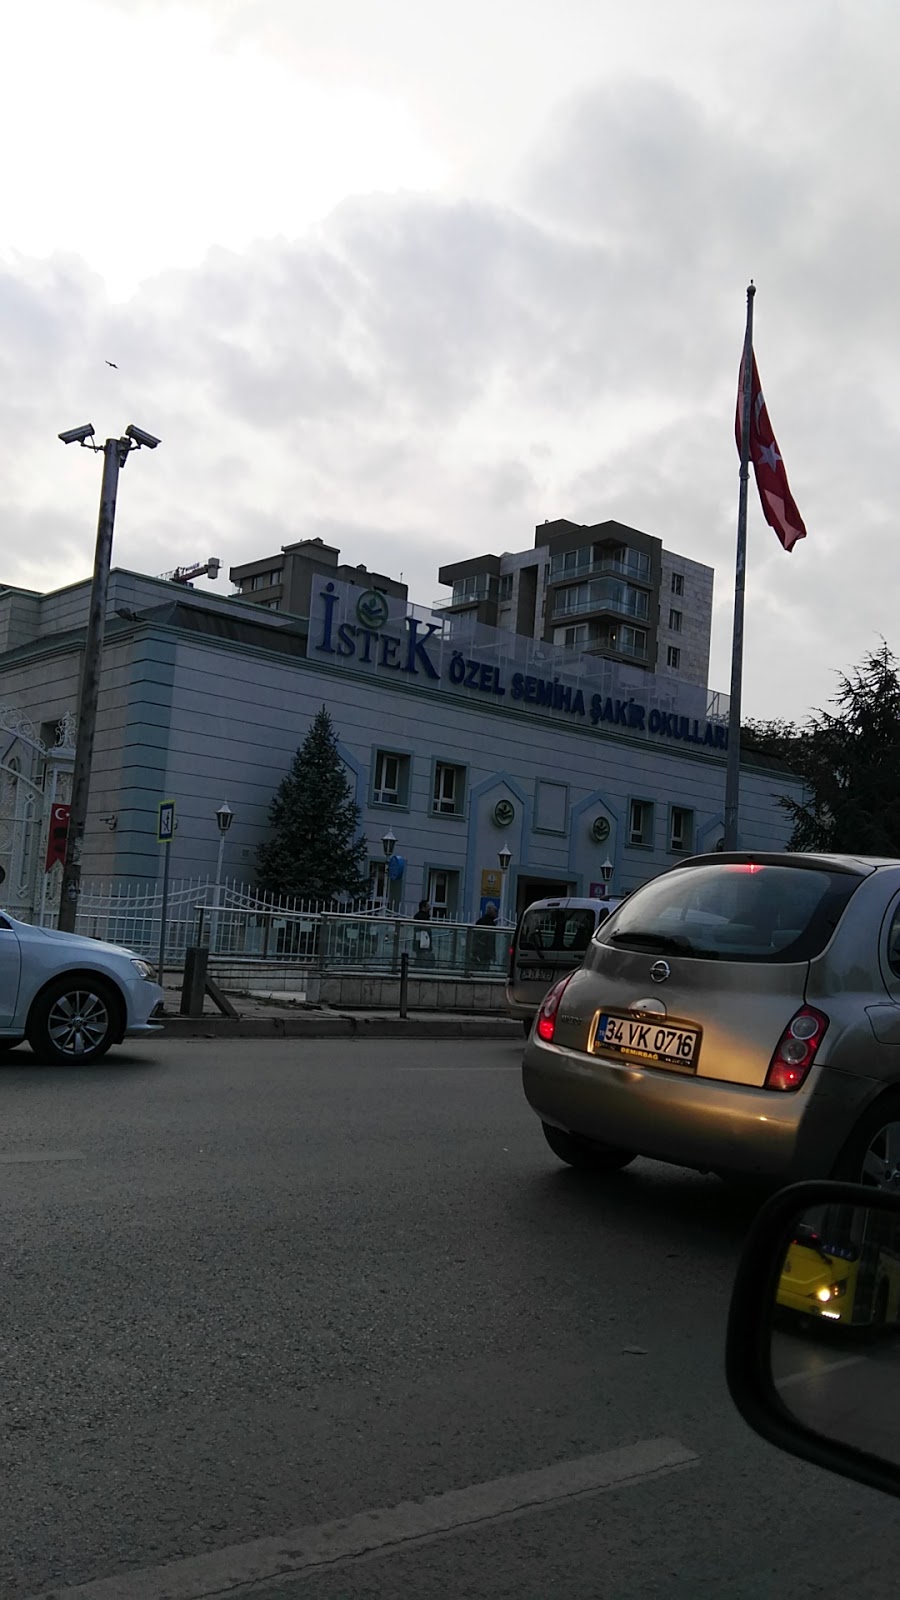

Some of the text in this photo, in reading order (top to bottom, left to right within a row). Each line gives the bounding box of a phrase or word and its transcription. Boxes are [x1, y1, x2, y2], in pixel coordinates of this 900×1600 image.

[315, 581, 442, 679] İSTEK
[449, 650, 729, 751] ÖZEL SEMİHA ŞAKİR OKULLARI
[605, 1020, 624, 1042] 34
[629, 1024, 651, 1048] VK
[654, 1029, 693, 1057] 0716
